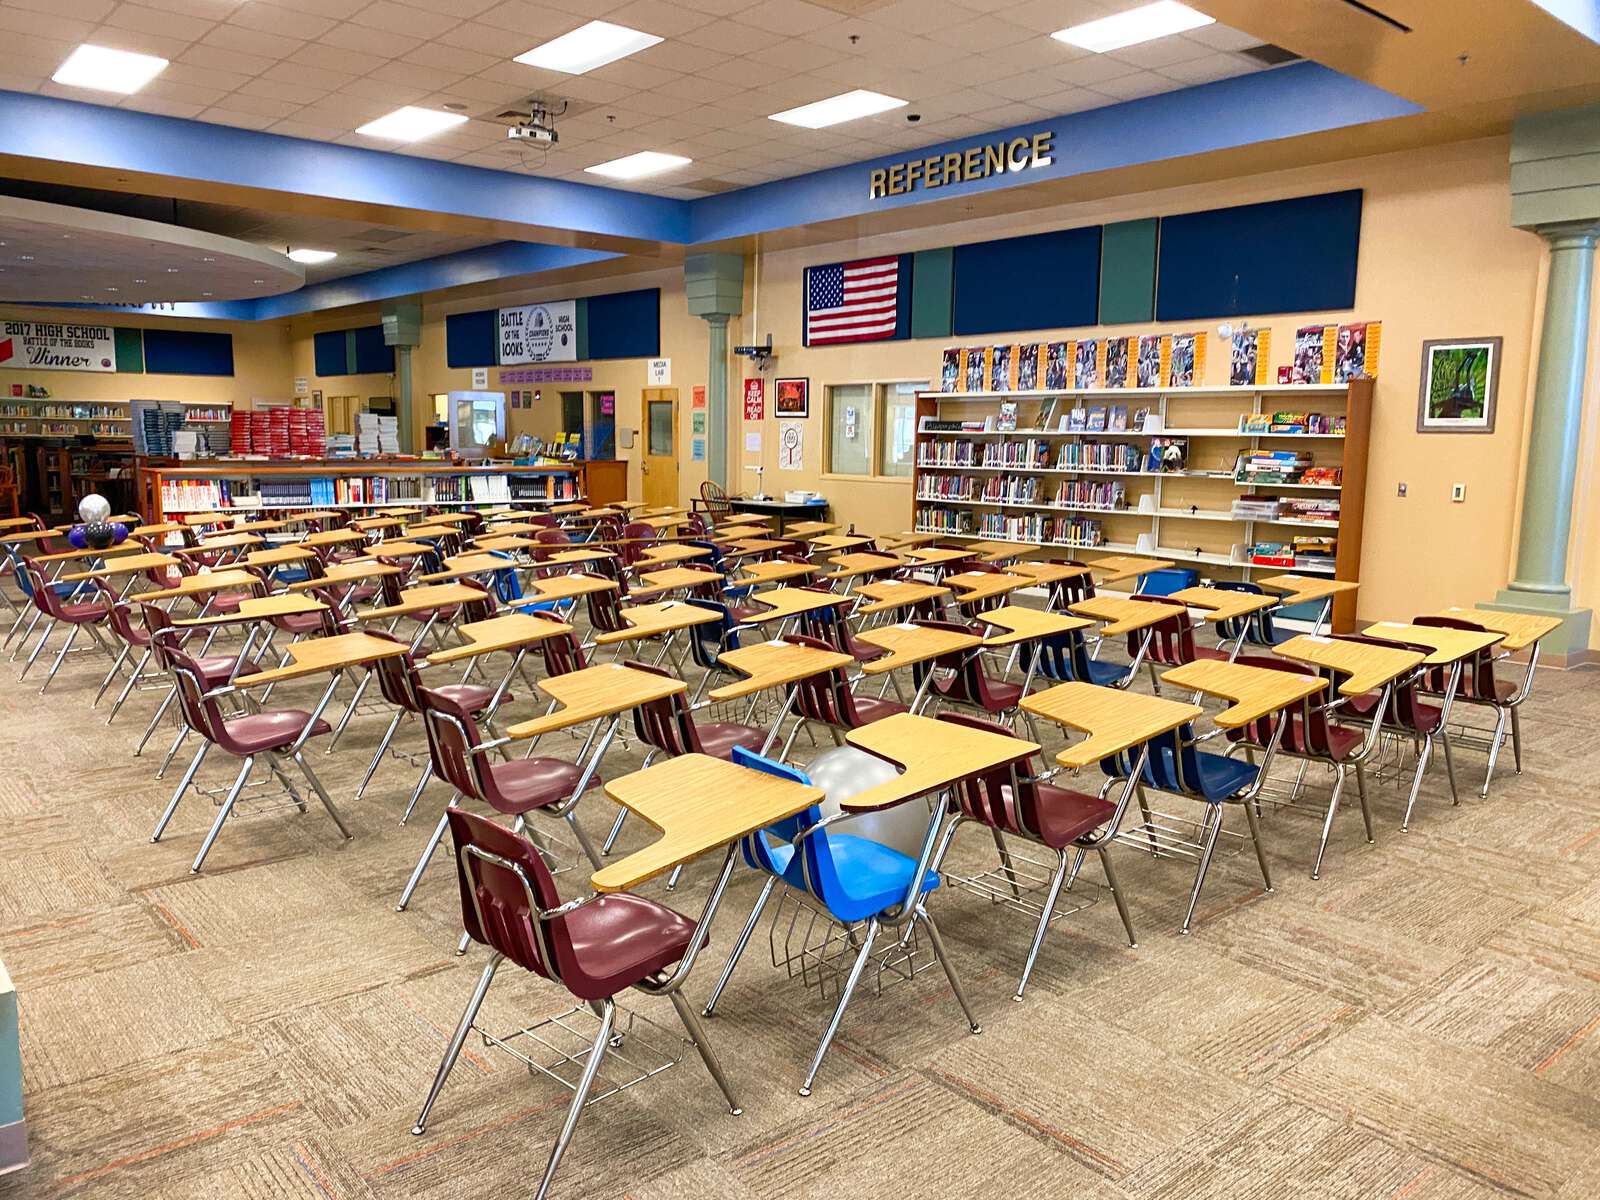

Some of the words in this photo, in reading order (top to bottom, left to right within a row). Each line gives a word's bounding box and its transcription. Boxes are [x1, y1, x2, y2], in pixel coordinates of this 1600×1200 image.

[869, 131, 1054, 200] REFERENCE
[501, 312, 523, 327] BATTLE
[558, 315, 570, 323] HIGH
[5, 323, 31, 335] 2017
[35, 324, 63, 337] HIGH
[67, 326, 110, 340] SCHOOL
[504, 331, 511, 340] OF
[511, 330, 520, 339] THE
[555, 324, 573, 332] SCHOOL
[23, 337, 48, 346] BATTLE
[60, 340, 73, 348] THE
[74, 340, 95, 348] BOOKS
[502, 342, 523, 357] BOOKS
[26, 347, 91, 367] Winner
